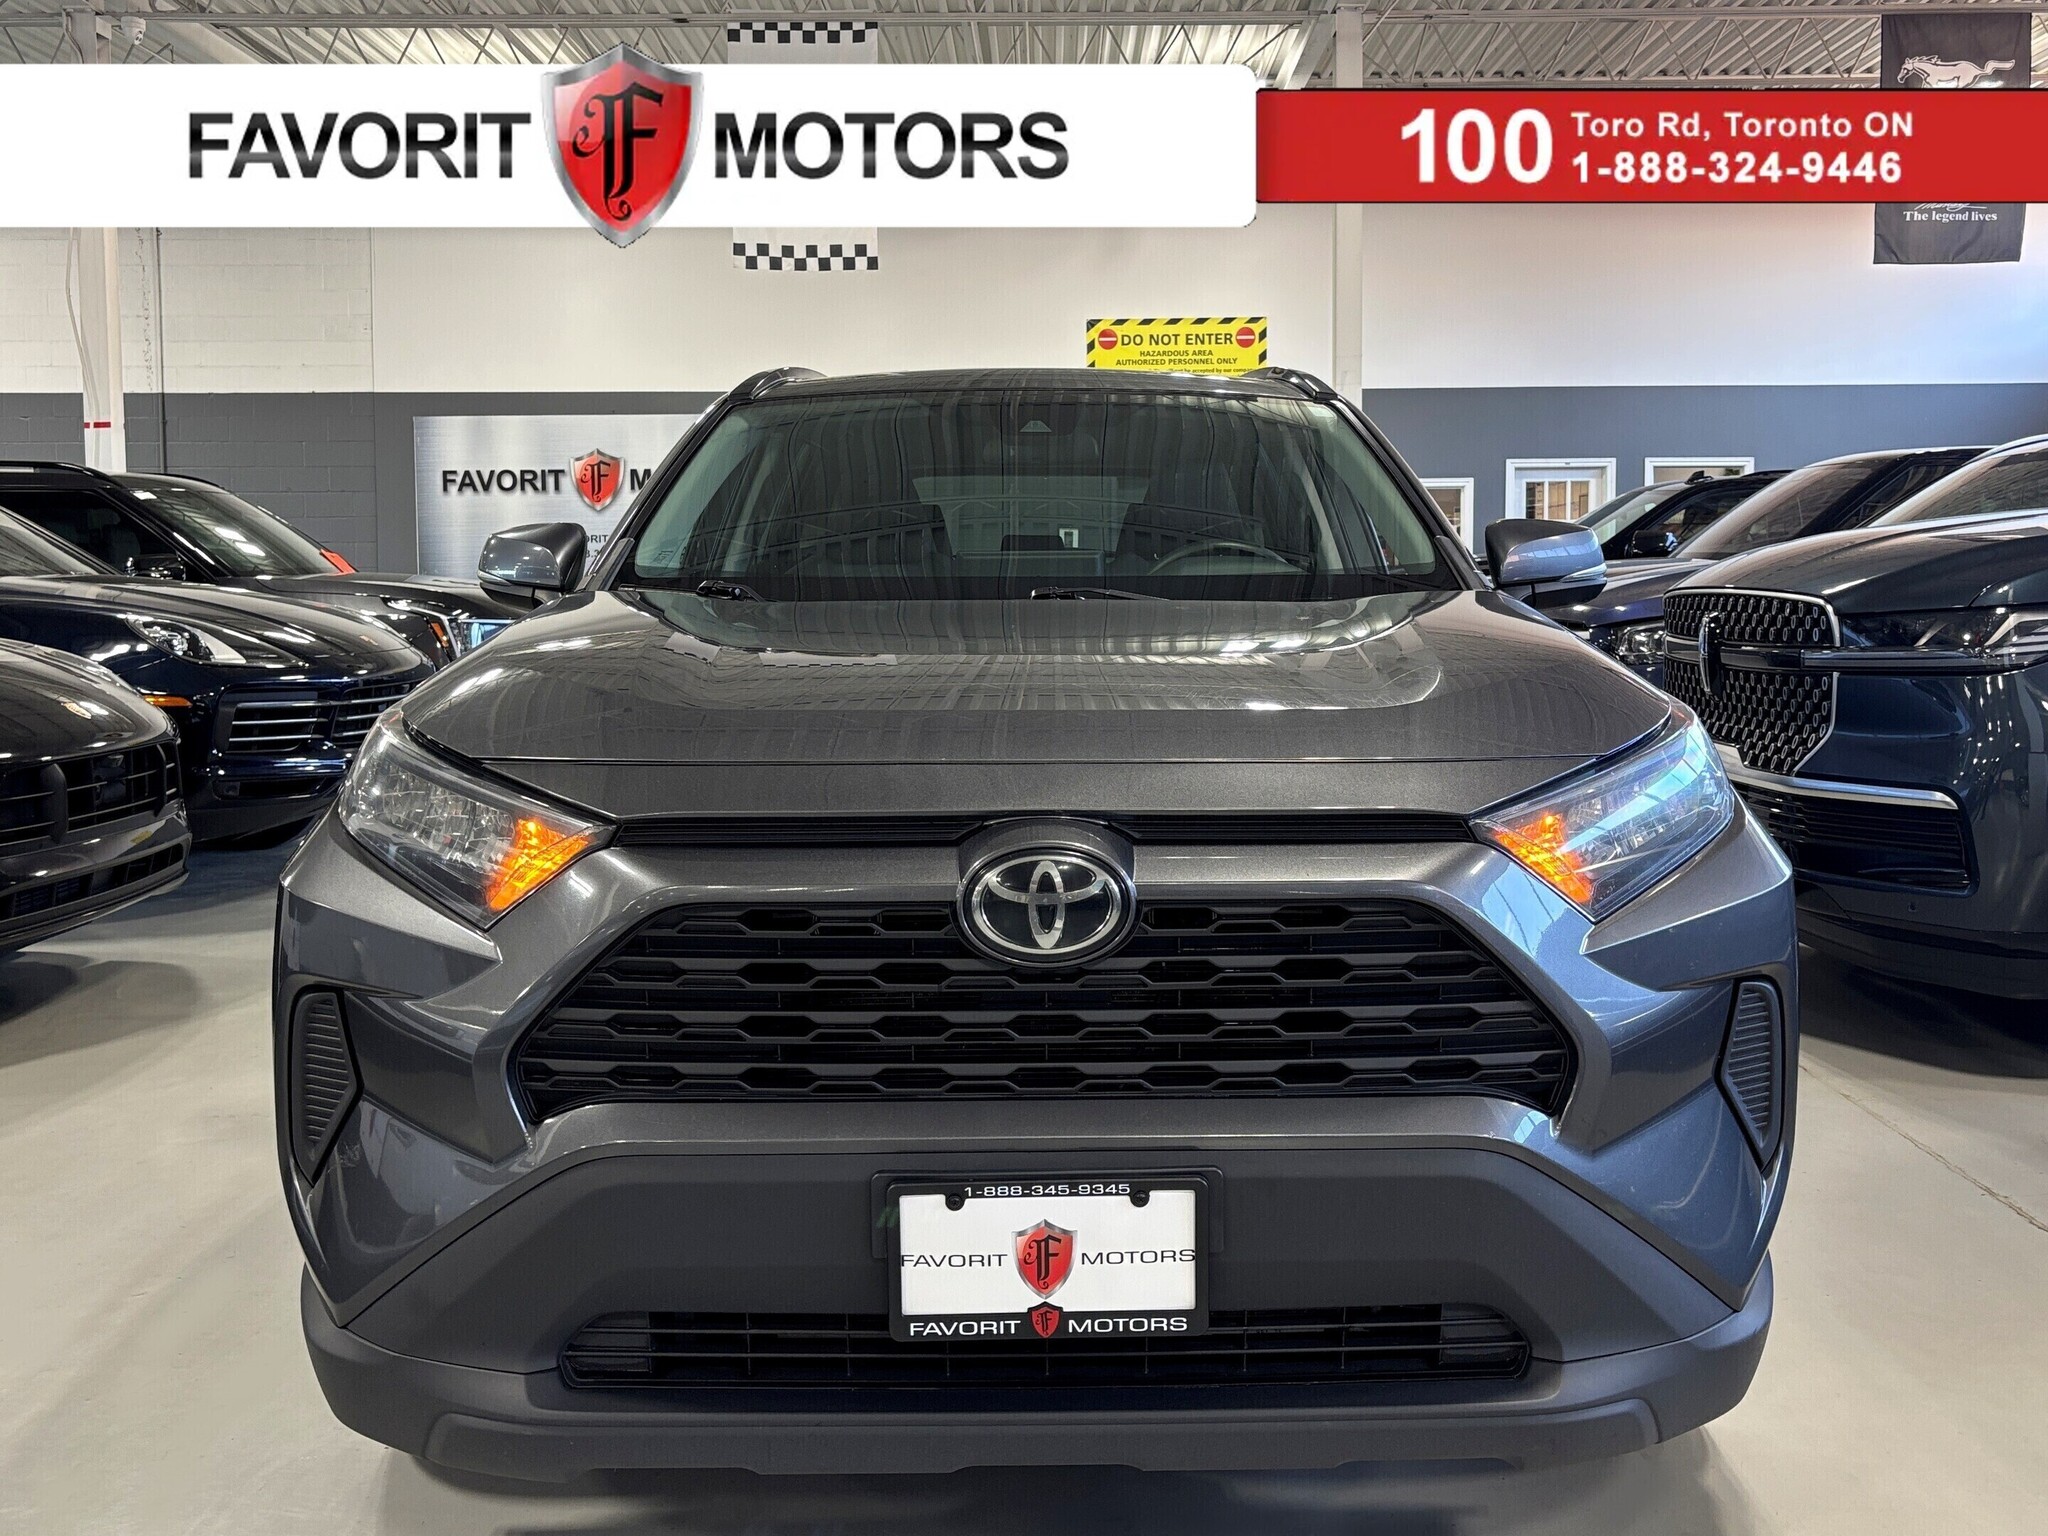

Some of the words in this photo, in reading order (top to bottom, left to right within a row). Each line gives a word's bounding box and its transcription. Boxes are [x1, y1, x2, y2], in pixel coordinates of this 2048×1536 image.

[1903, 211, 1929, 222] The
[1932, 210, 1969, 223] legend
[1971, 211, 1998, 221] lives
[1120, 334, 1144, 347] DO
[1149, 334, 1180, 346] NOT
[1185, 333, 1234, 346] ENTER
[1139, 349, 1190, 358] HAZARDOUS
[1191, 349, 1214, 357] AREA
[1115, 358, 1166, 366] AUTHORIZED
[1168, 357, 1215, 366] PERSONNEL
[1216, 357, 1238, 365] ONLY
[442, 469, 566, 493] FAVORIT
[964, 1183, 1131, 1198] 1-888-345-9345
[901, 1253, 1009, 1268] FAVORIT
[1081, 1248, 1196, 1266] MOTORS
[909, 1319, 1022, 1337] FAVORIT
[1068, 1316, 1188, 1334] MOTORS
